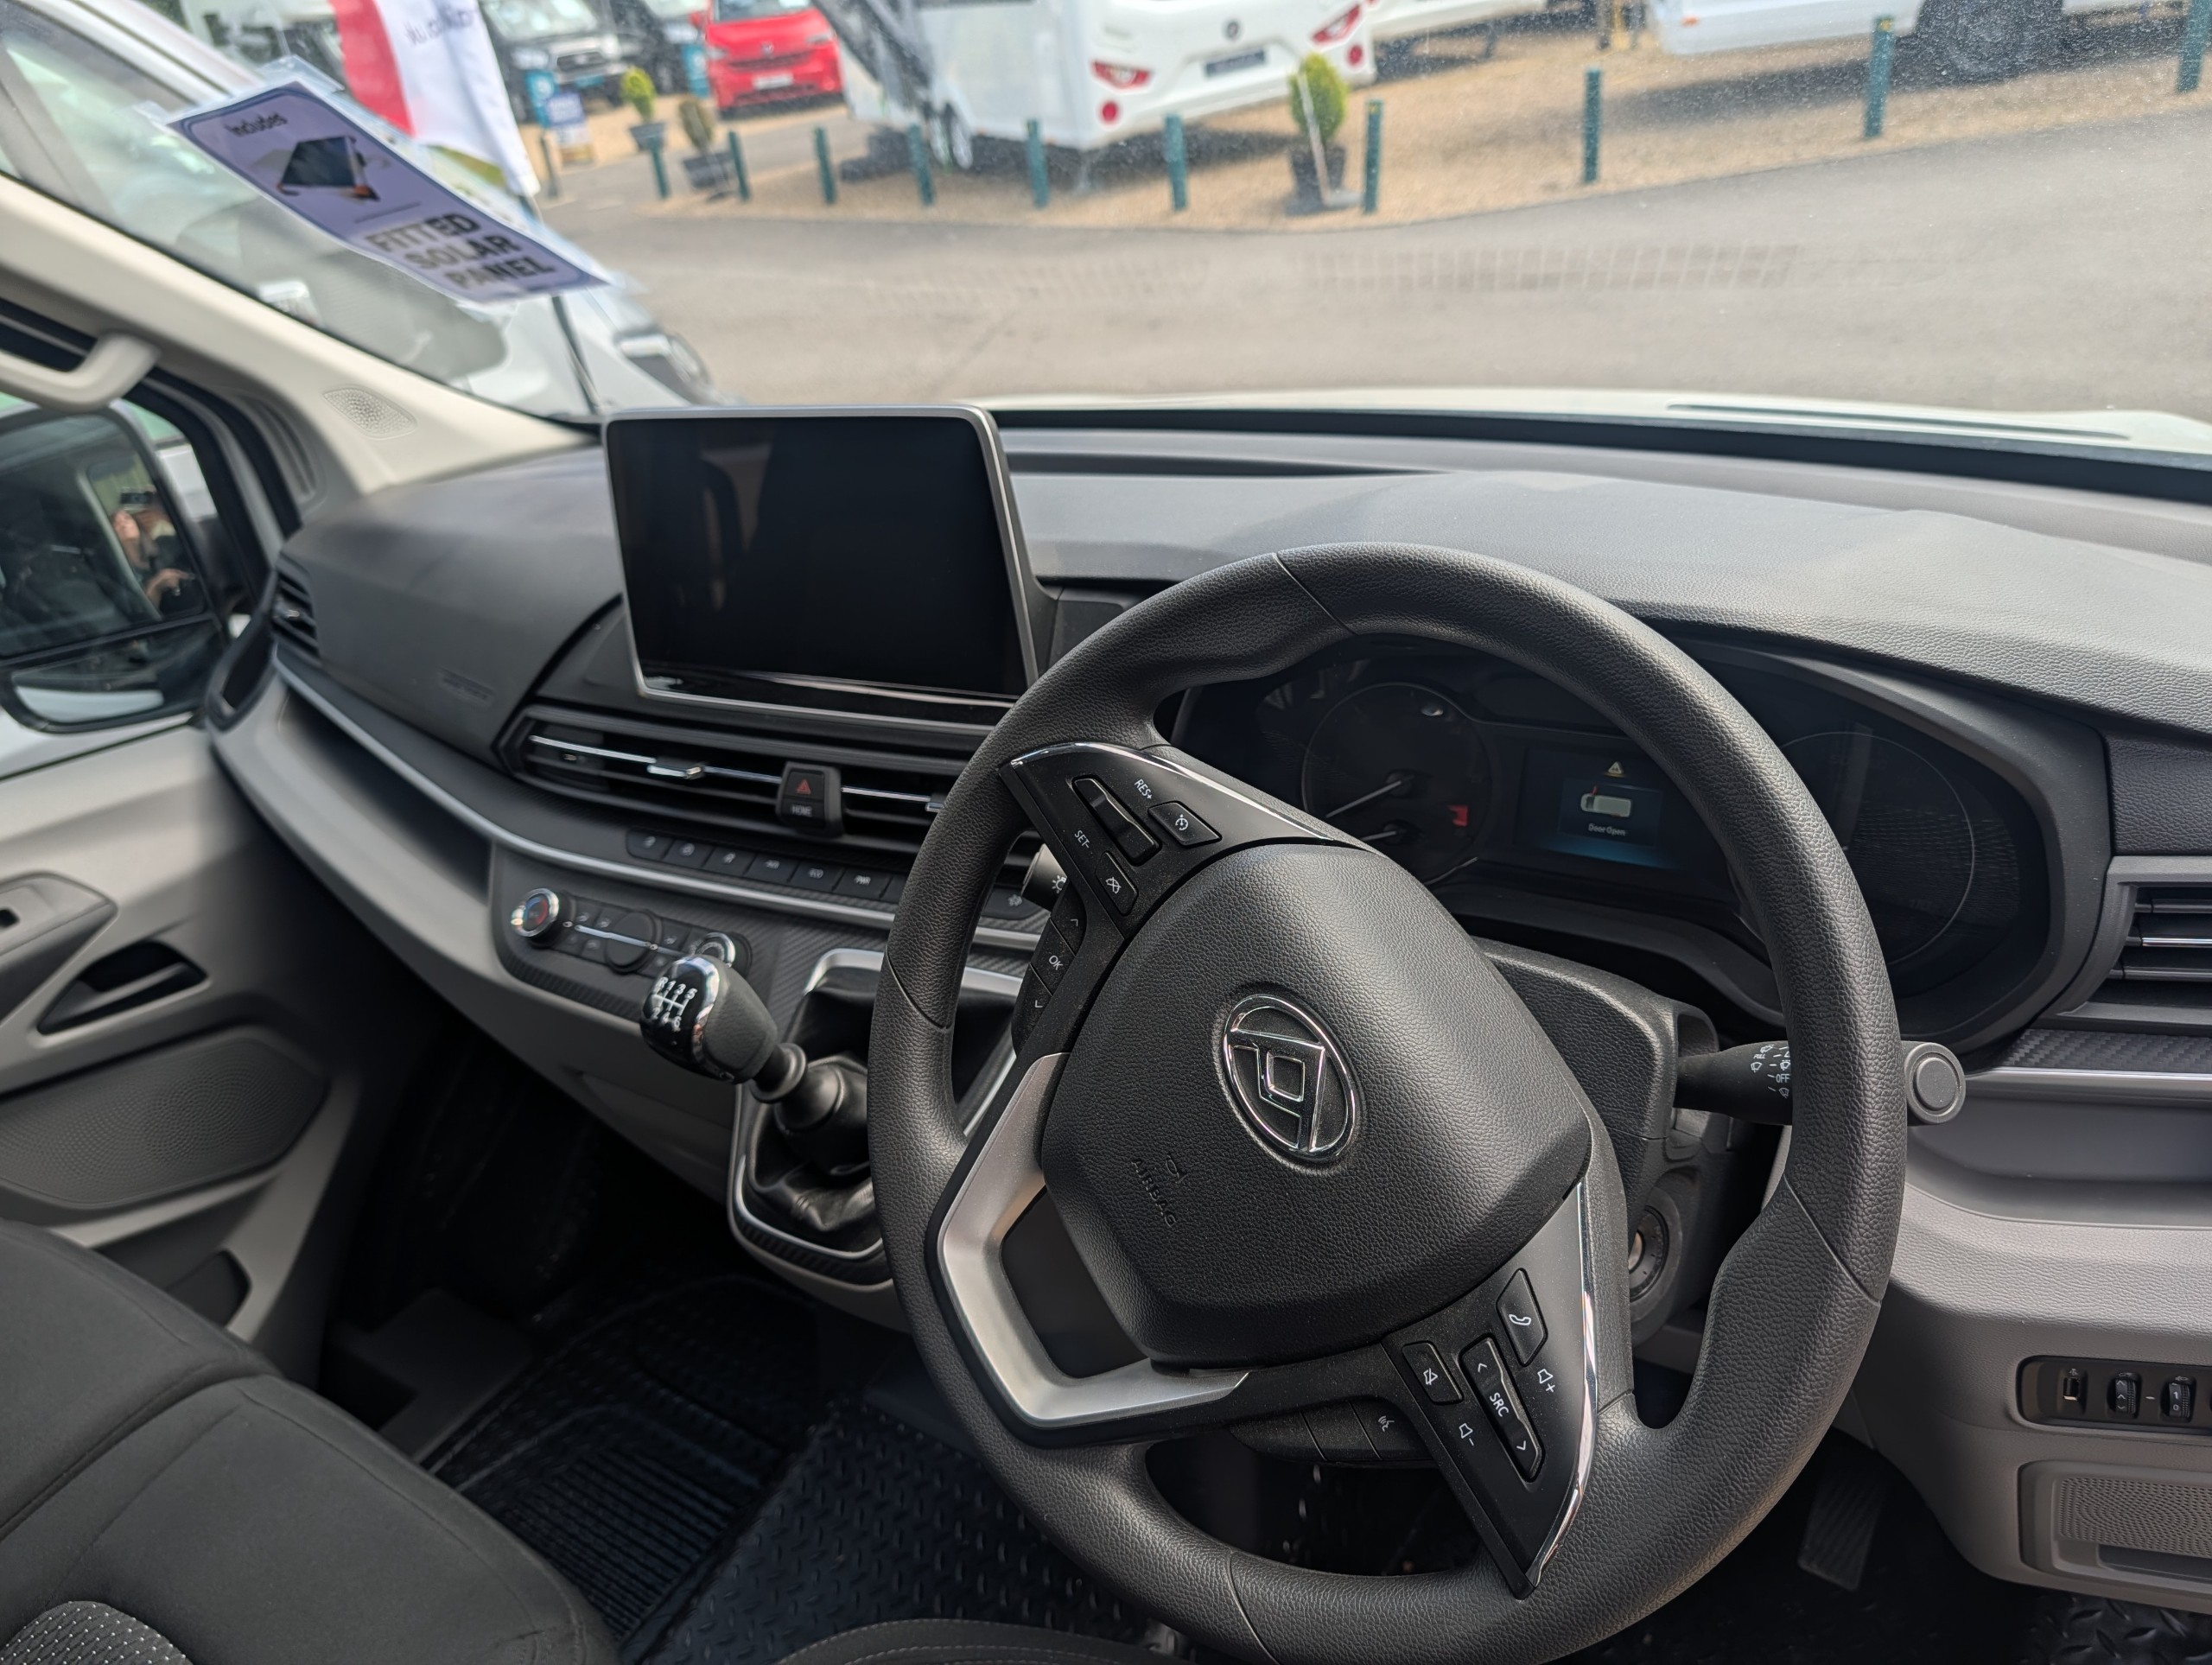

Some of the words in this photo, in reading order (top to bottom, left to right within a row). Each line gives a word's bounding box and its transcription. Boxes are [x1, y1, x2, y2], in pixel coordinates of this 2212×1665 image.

[364, 213, 481, 252] FITTED
[404, 234, 521, 270] SOLAR
[444, 257, 557, 289] PANEL
[1134, 778, 1153, 800] RES+
[1606, 826, 1626, 836] Open
[1048, 955, 1064, 971] OK
[674, 983, 686, 995] 3
[684, 988, 698, 1000] 5
[651, 1007, 661, 1020] 2
[671, 1015, 682, 1032] 6
[1776, 1073, 1791, 1084] OFF
[1130, 1160, 1177, 1228] AIRBAG
[1489, 1392, 1510, 1417] SRC
